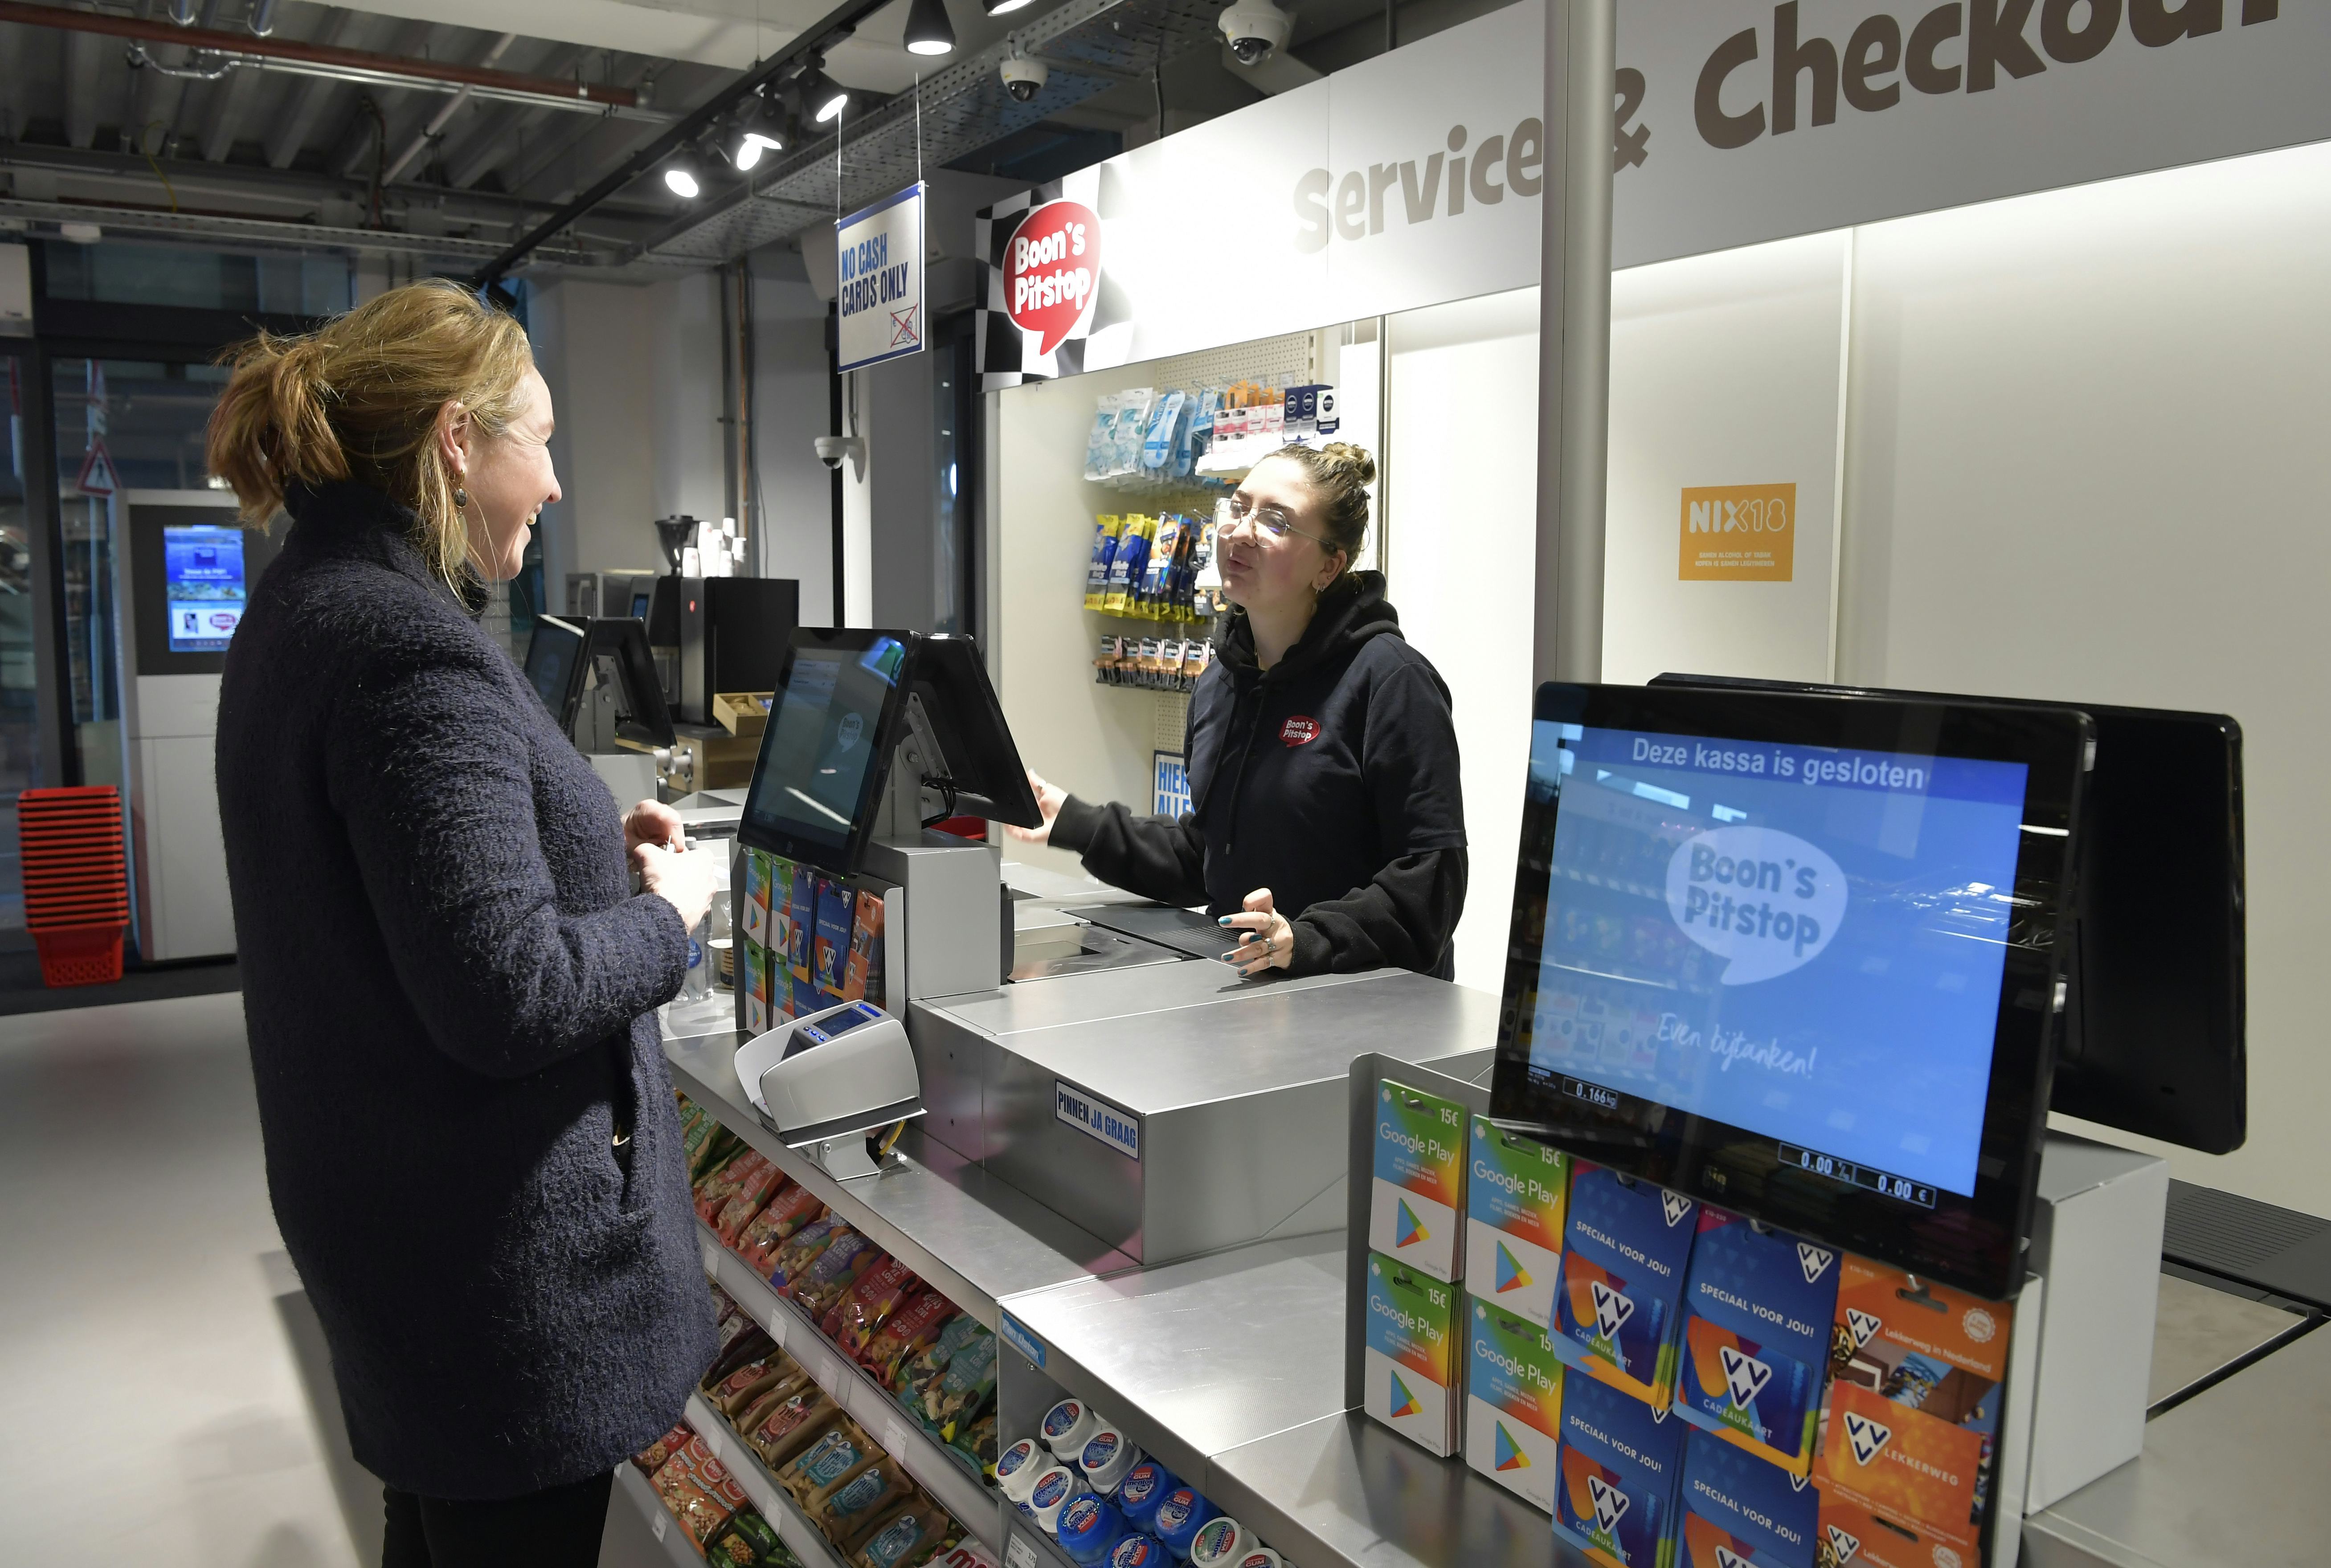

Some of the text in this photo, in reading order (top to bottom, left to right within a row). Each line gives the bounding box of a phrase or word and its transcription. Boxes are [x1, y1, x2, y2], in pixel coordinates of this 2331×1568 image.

[1293, 117, 1543, 254] Service
[842, 233, 887, 282] NO CASH
[1014, 222, 1086, 275] Boon's
[842, 261, 908, 318] CARDS ONLY
[1014, 267, 1091, 314] Pitstop
[1283, 729, 1312, 741] Pitstop
[1286, 720, 1313, 730] Boon's
[1633, 737, 1923, 789] Deze kassa is gesloten
[1688, 842, 1818, 900] Boon's
[1685, 885, 1820, 957] Pitstop
[1656, 1012, 1702, 1048] Even
[1058, 1090, 1136, 1149] PINNEN JA GRAAG
[1440, 1108, 1458, 1127] 15€
[1380, 1122, 1455, 1167] Google Play
[1540, 1146, 1561, 1167] 15€
[1801, 1152, 1833, 1175] 0.00
[1474, 1160, 1558, 1210] Google Play
[1877, 1175, 1912, 1200] 0.00
[1576, 1221, 1671, 1278] SPECIAAL VOOR JOU!
[1428, 1288, 1446, 1309] 15€
[1700, 1282, 1815, 1338] SPECIAAL VOOR JOU!
[1370, 1294, 1444, 1347] Google Play
[1575, 1328, 1632, 1369] CADEAUKAART
[1885, 1327, 1992, 1373] Lekkerweg in Nederland
[1475, 1339, 1556, 1396] Google Play
[1058, 1407, 1073, 1425] mentos
[1066, 1405, 1076, 1417] GUM
[1526, 1400, 1538, 1413] MEER
[1703, 1398, 1773, 1439] CADEAUKAART
[1009, 1450, 1025, 1461] mentos
[1017, 1446, 1027, 1454] GUM
[1091, 1441, 1115, 1450] mentos
[1570, 1415, 1662, 1473] SPECIAAL VOOR JOU!
[1039, 1475, 1056, 1489] GUM
[1884, 1447, 1959, 1486] LEKKERWEG
[1035, 1476, 1063, 1498] mentos
[1049, 1495, 1060, 1505] 40
[1173, 1497, 1189, 1506] GUM
[1069, 1503, 1096, 1528] mentos
[1077, 1512, 1096, 1529] GUM
[1166, 1501, 1190, 1513] mentos
[1694, 1479, 1802, 1545] SPECIAAL VOOR JOU!
[1130, 1544, 1142, 1565] GUM
[1212, 1525, 1227, 1558] mentos
[1220, 1532, 1231, 1552] GUM
[1575, 1521, 1632, 1562] CADEAUKAART
[1245, 1560, 1265, 1568] GUM
